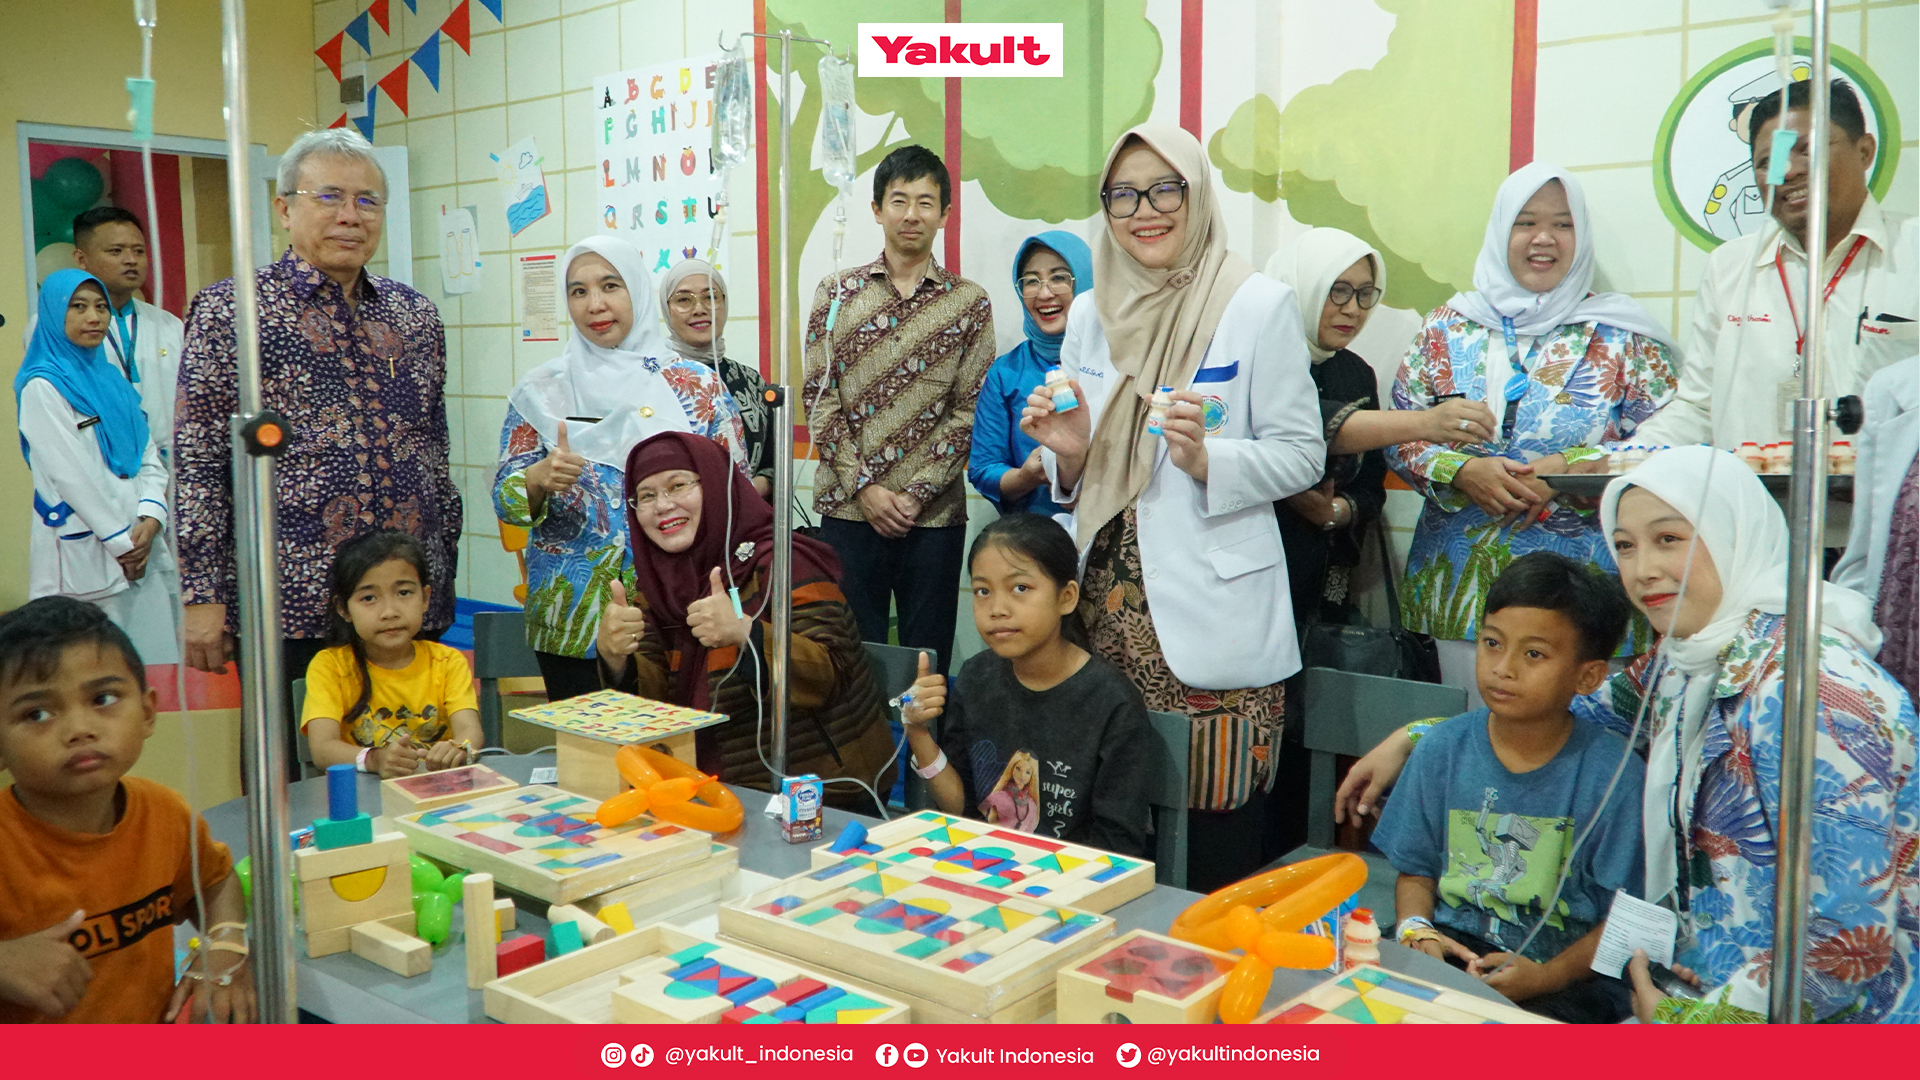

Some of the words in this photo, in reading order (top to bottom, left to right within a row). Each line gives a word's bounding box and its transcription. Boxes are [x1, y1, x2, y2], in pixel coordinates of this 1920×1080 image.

[600, 86, 615, 109] A
[624, 78, 639, 104] B
[679, 67, 691, 94] D
[604, 117, 614, 144] F
[625, 110, 637, 139] G
[651, 106, 666, 134] H
[684, 100, 697, 128] J
[603, 160, 615, 187] L
[624, 157, 641, 185] M
[652, 154, 666, 182] N
[680, 147, 696, 176] O
[604, 205, 617, 229] Q
[630, 203, 644, 230] R
[655, 199, 668, 225] S
[682, 197, 697, 224] T
[653, 249, 670, 273] X
[1042, 781, 1077, 799] super
[1046, 800, 1074, 817] girls
[68, 924, 114, 952] OL
[121, 895, 173, 938] SPOR
